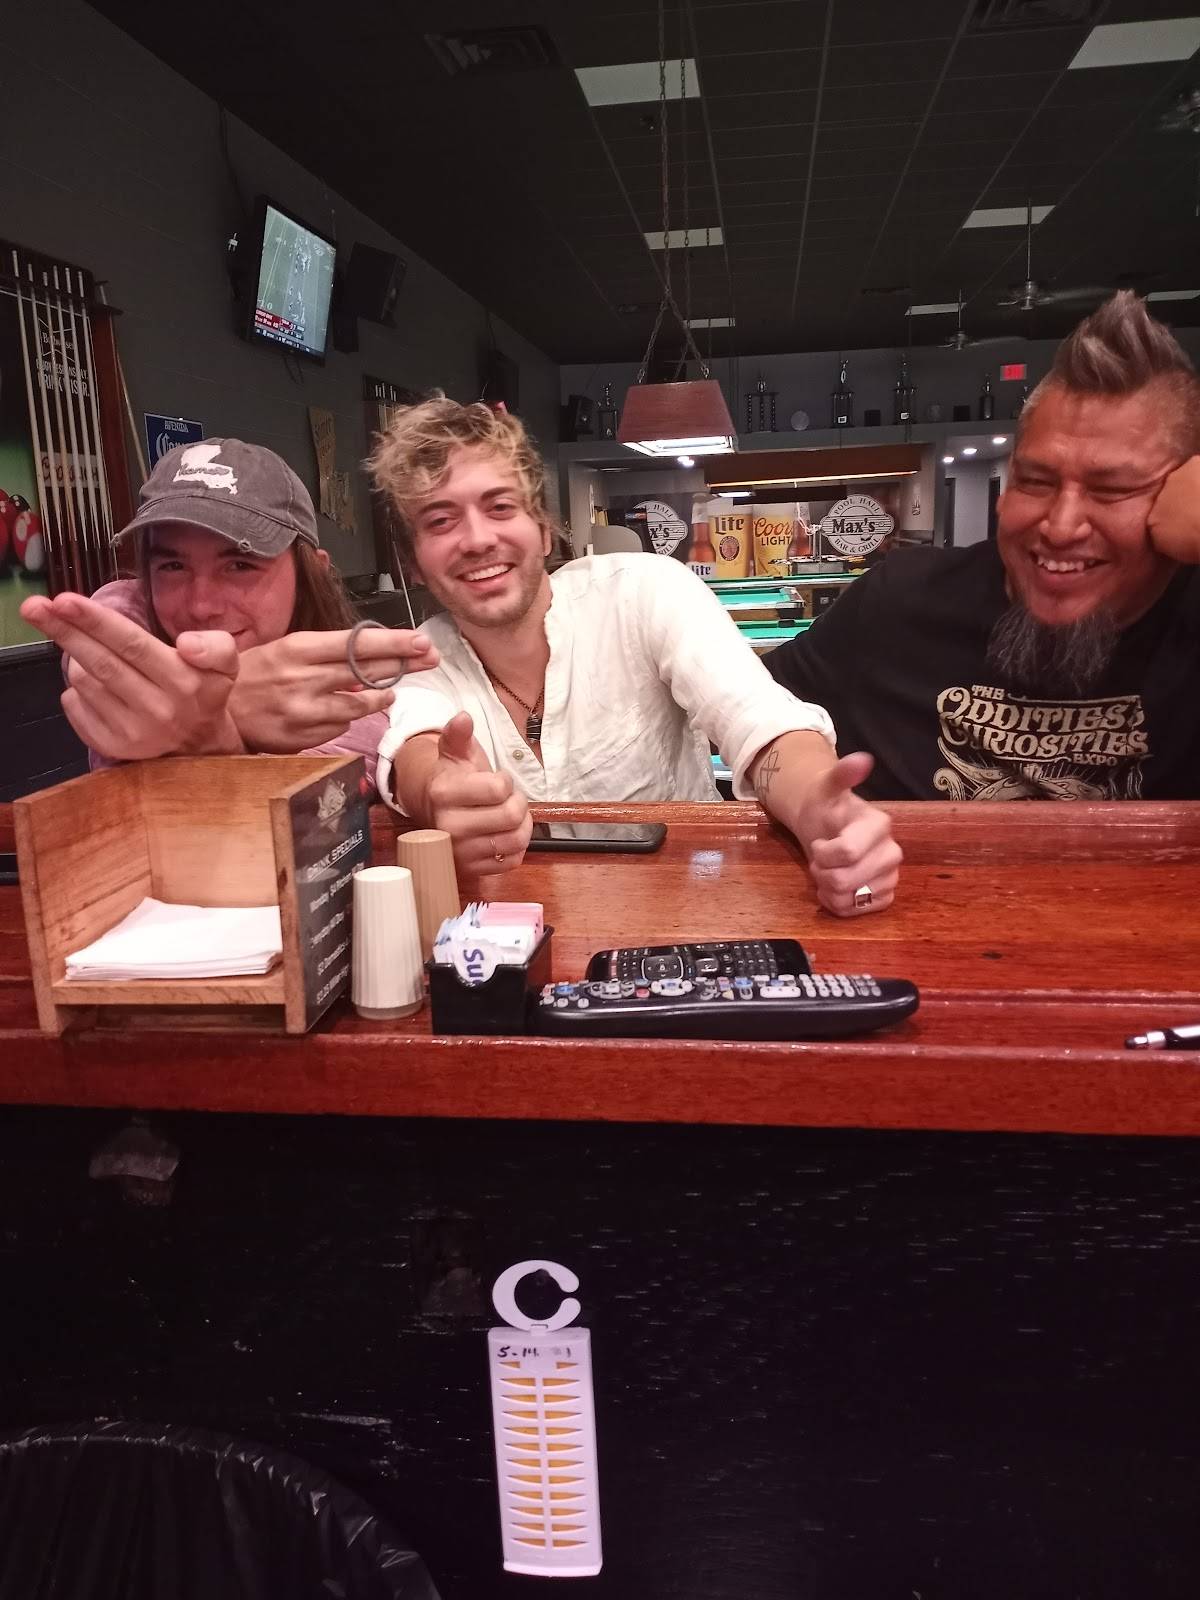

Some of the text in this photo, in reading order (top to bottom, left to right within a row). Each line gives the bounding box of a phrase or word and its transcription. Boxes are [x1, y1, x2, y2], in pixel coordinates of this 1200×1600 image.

[653, 503, 674, 518] HALL
[834, 497, 881, 515] POOL HALL
[649, 524, 670, 539] x's
[714, 516, 745, 535] Lite
[753, 517, 793, 538] Coor
[832, 517, 876, 534] Max's
[761, 536, 792, 546] LIGHT
[834, 538, 848, 551] BAR
[858, 538, 881, 553] GRILL
[971, 684, 1006, 701] THE
[937, 686, 1129, 732] ODDITIES
[939, 713, 1149, 758] CURIOSITIES
[1073, 753, 1118, 767] EXPO
